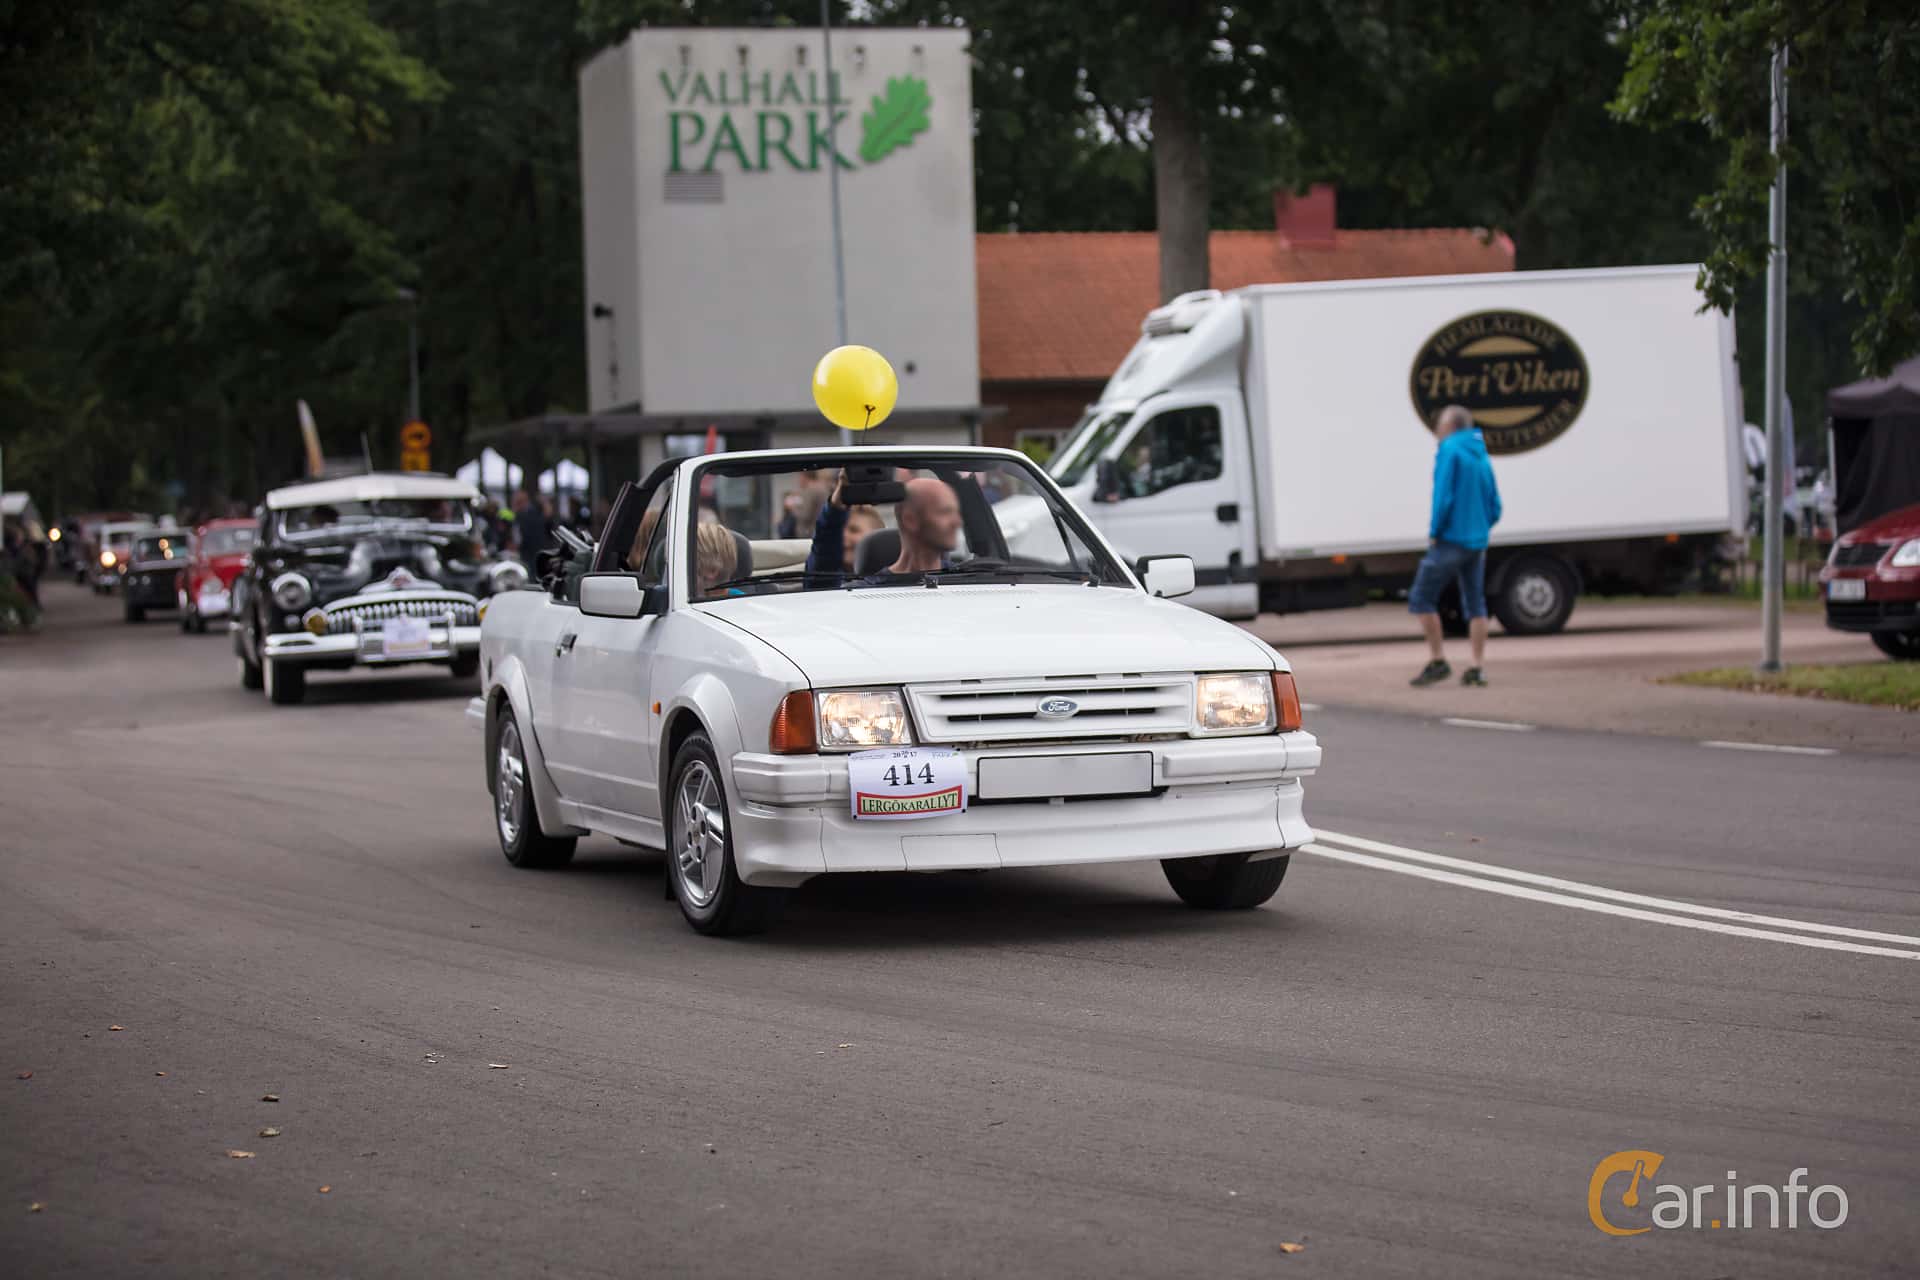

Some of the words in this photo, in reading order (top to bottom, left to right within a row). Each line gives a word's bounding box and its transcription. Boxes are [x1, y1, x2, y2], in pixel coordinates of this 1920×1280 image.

[658, 70, 852, 105] VALHALL
[667, 110, 859, 172] PARK
[1419, 366, 1476, 397] Per
[1491, 359, 1581, 395] Viken
[883, 762, 935, 786] 414
[862, 792, 958, 813] LERGÖKARALLYT
